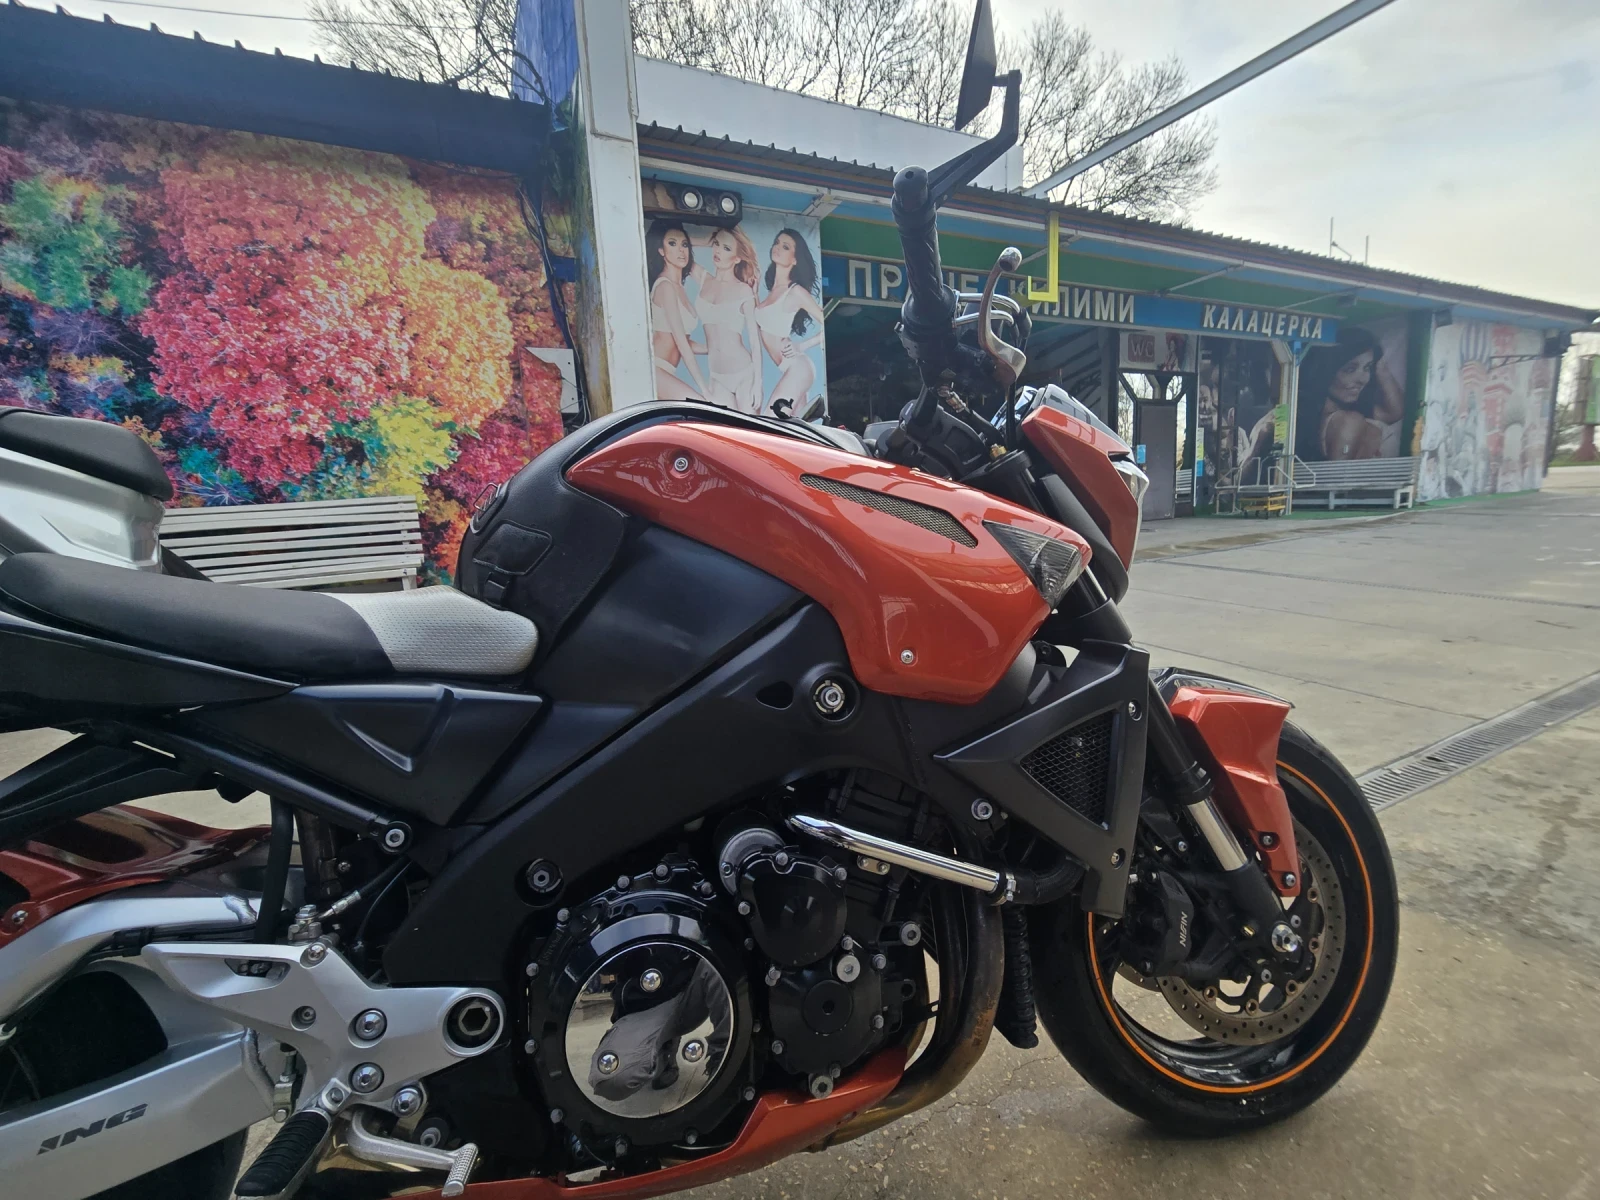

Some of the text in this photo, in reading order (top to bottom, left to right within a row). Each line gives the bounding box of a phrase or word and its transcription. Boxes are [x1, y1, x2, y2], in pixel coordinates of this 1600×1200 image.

[849, 260, 979, 306] ПРЕ
[1203, 304, 1322, 339] КАЛАЦЕРКА
[1131, 339, 1154, 357] WC
